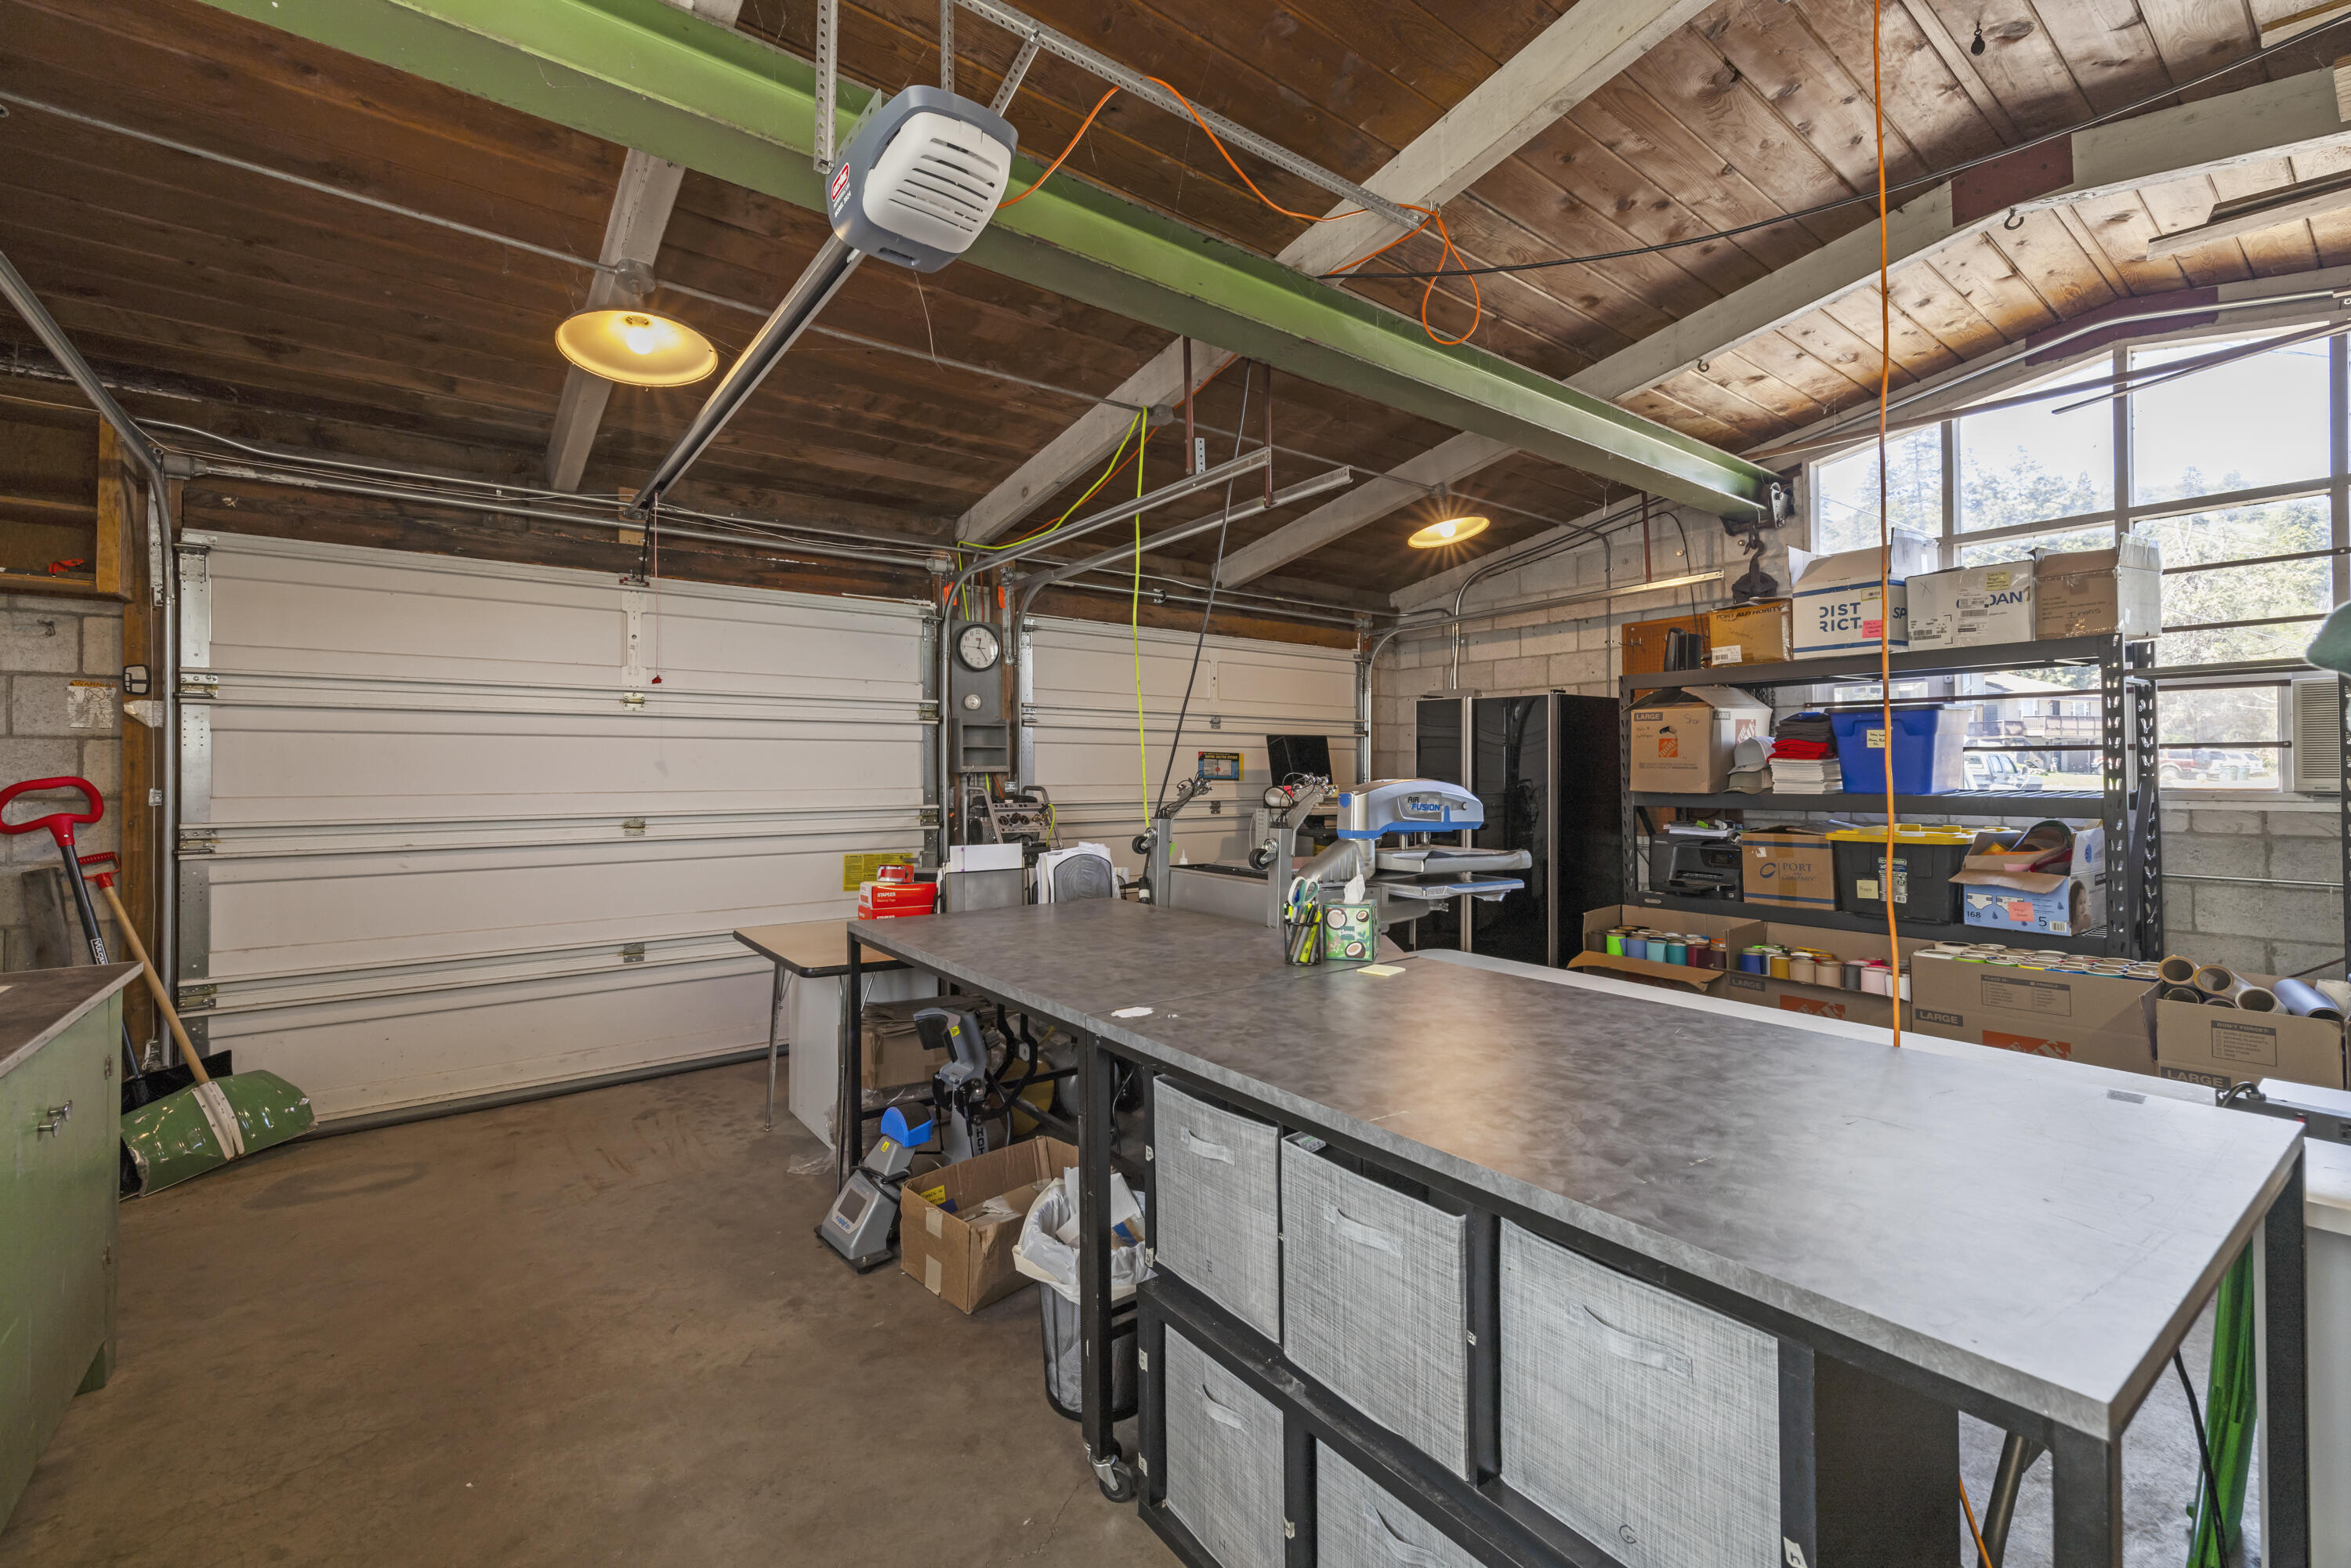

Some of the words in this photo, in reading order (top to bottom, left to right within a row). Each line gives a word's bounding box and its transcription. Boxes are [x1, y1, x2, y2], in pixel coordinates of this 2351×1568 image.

[1735, 606, 1783, 617] AUTHORITY
[1819, 602, 1861, 619] DIST
[1782, 863, 1813, 872] PORT
[2038, 917, 2047, 927] 5
[1732, 979, 1762, 989] LARGE
[1920, 1011, 1958, 1024] LARGE
[2240, 1025, 2269, 1034] FORGET!
[2167, 1070, 2224, 1088] LARGE
[1619, 1524, 1637, 1544] G
